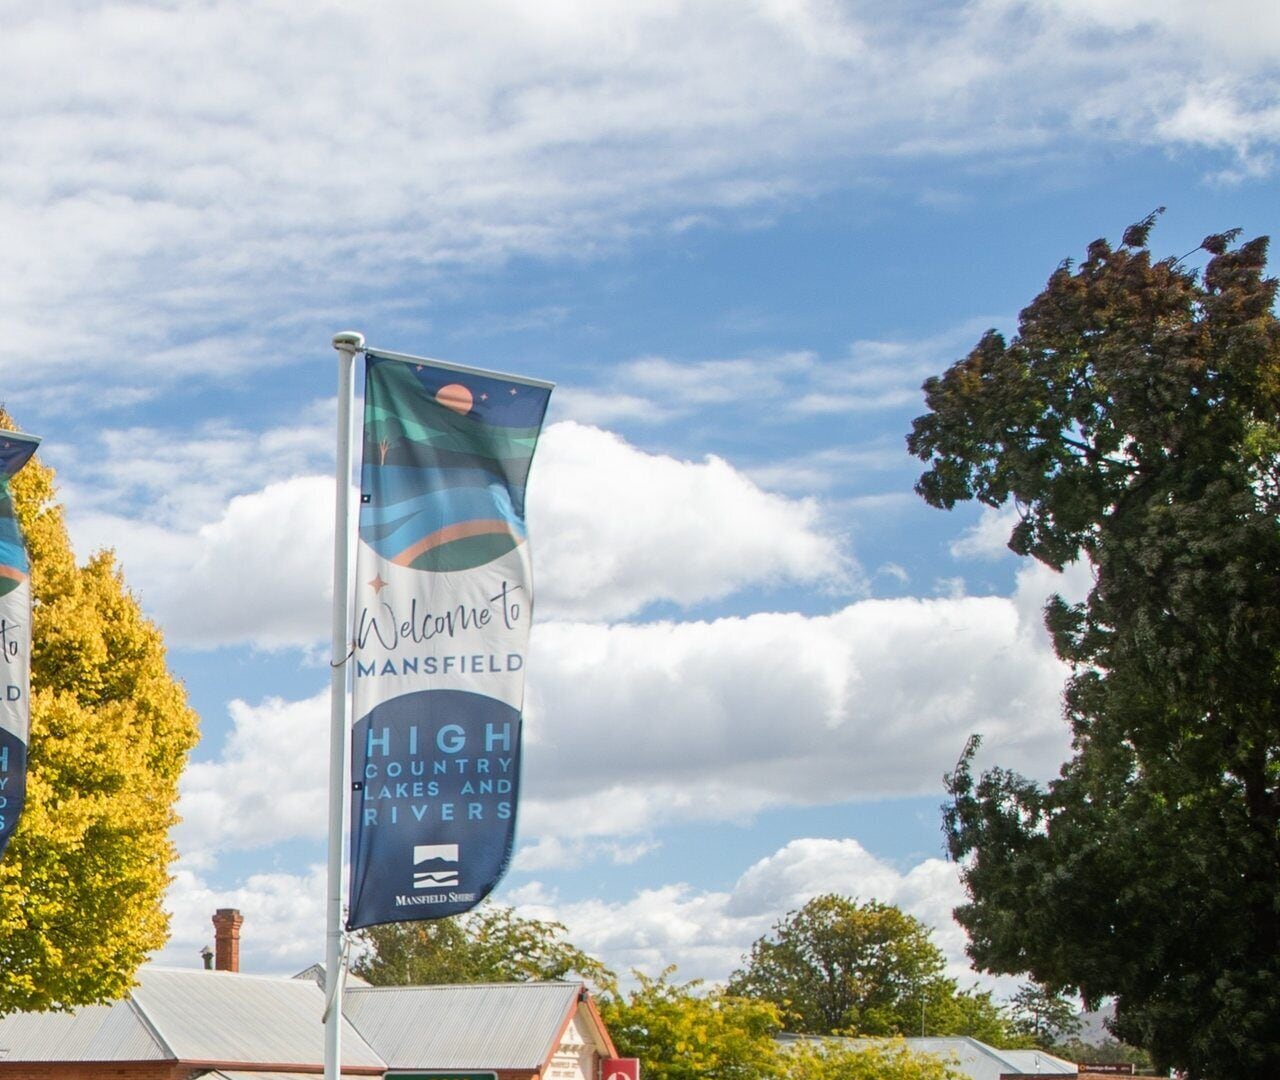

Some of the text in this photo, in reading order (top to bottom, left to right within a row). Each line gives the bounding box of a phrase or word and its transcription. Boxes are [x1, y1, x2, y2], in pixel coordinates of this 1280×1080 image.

[357, 581, 524, 651] Welcome to
[356, 653, 524, 678] MANSFIELD
[367, 722, 511, 758] HIGH
[365, 757, 512, 779] COUNTRY
[364, 779, 512, 801] LAKES AND
[364, 801, 512, 827] RIVERS
[395, 893, 447, 907] MANSFIELD
